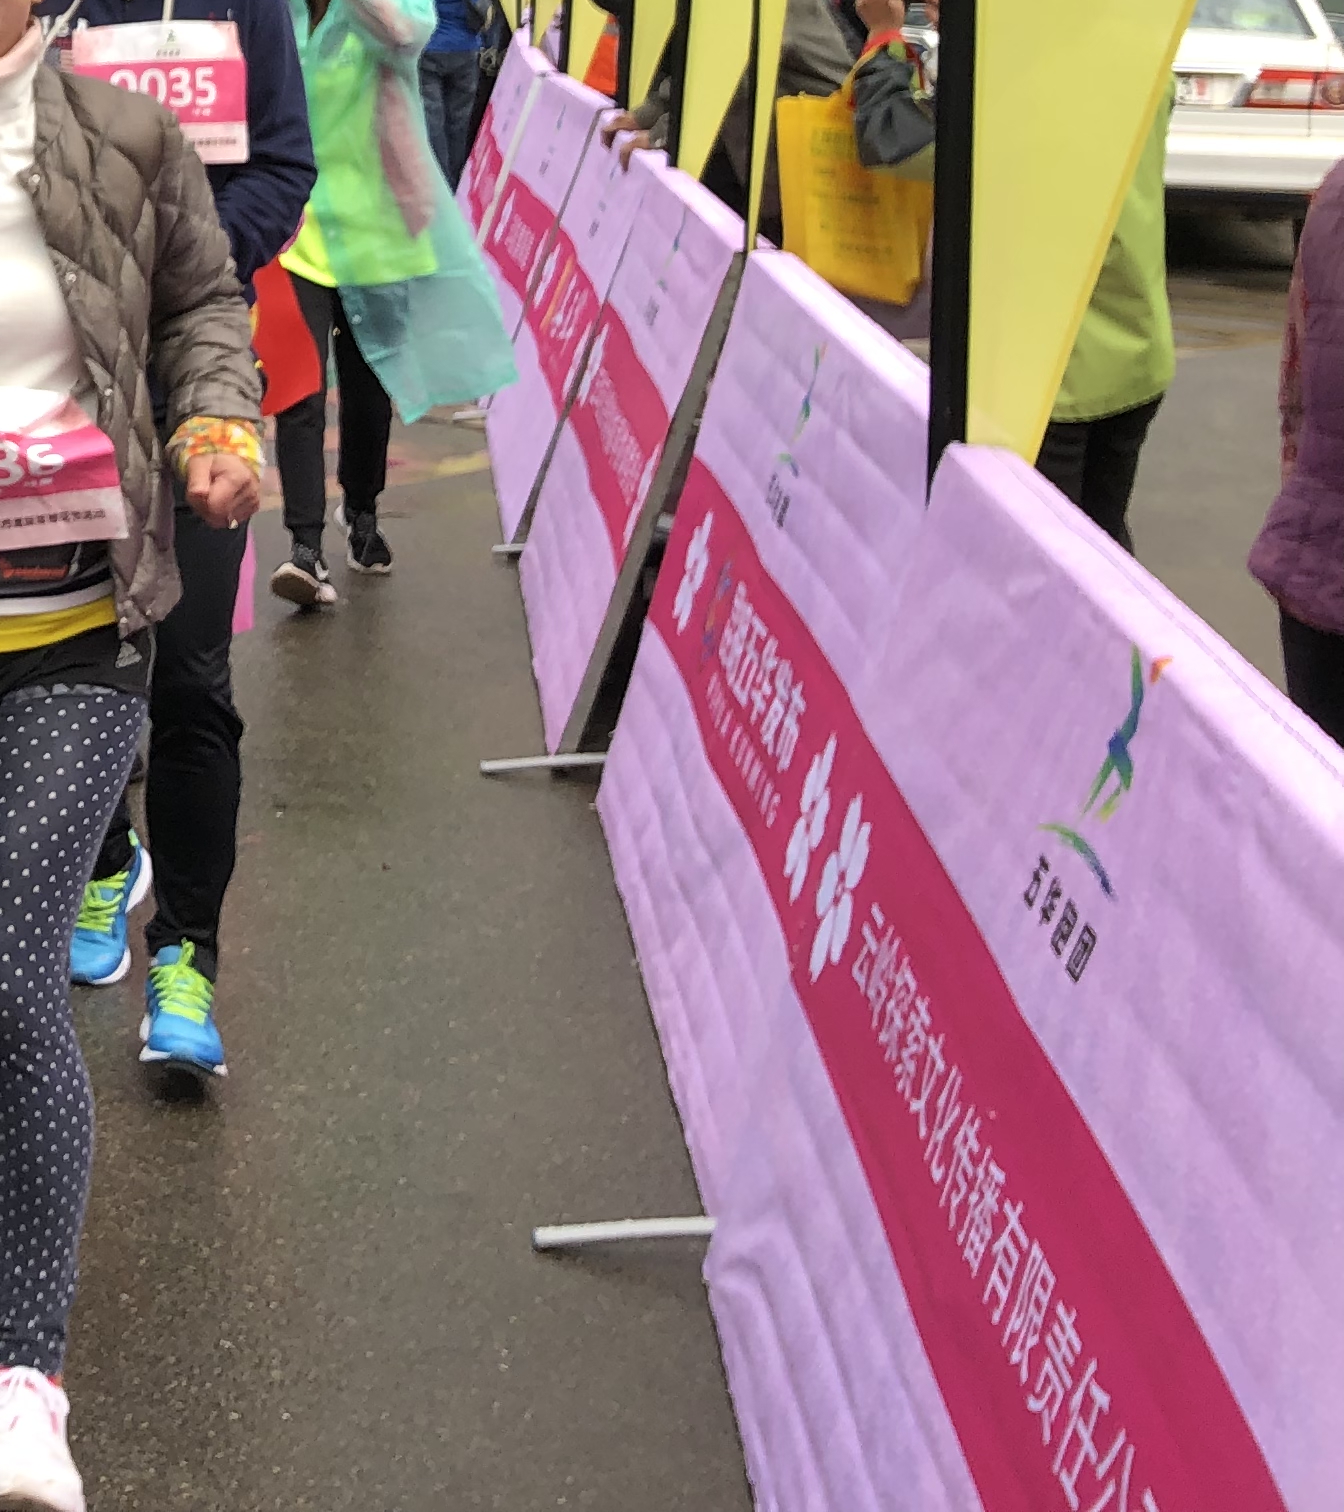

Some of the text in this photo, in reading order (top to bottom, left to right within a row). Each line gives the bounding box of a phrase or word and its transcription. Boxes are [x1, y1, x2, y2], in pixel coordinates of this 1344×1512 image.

[110, 65, 218, 108] 0035
[852, 902, 1160, 1512] 云岭探索文化传播有限责任公
